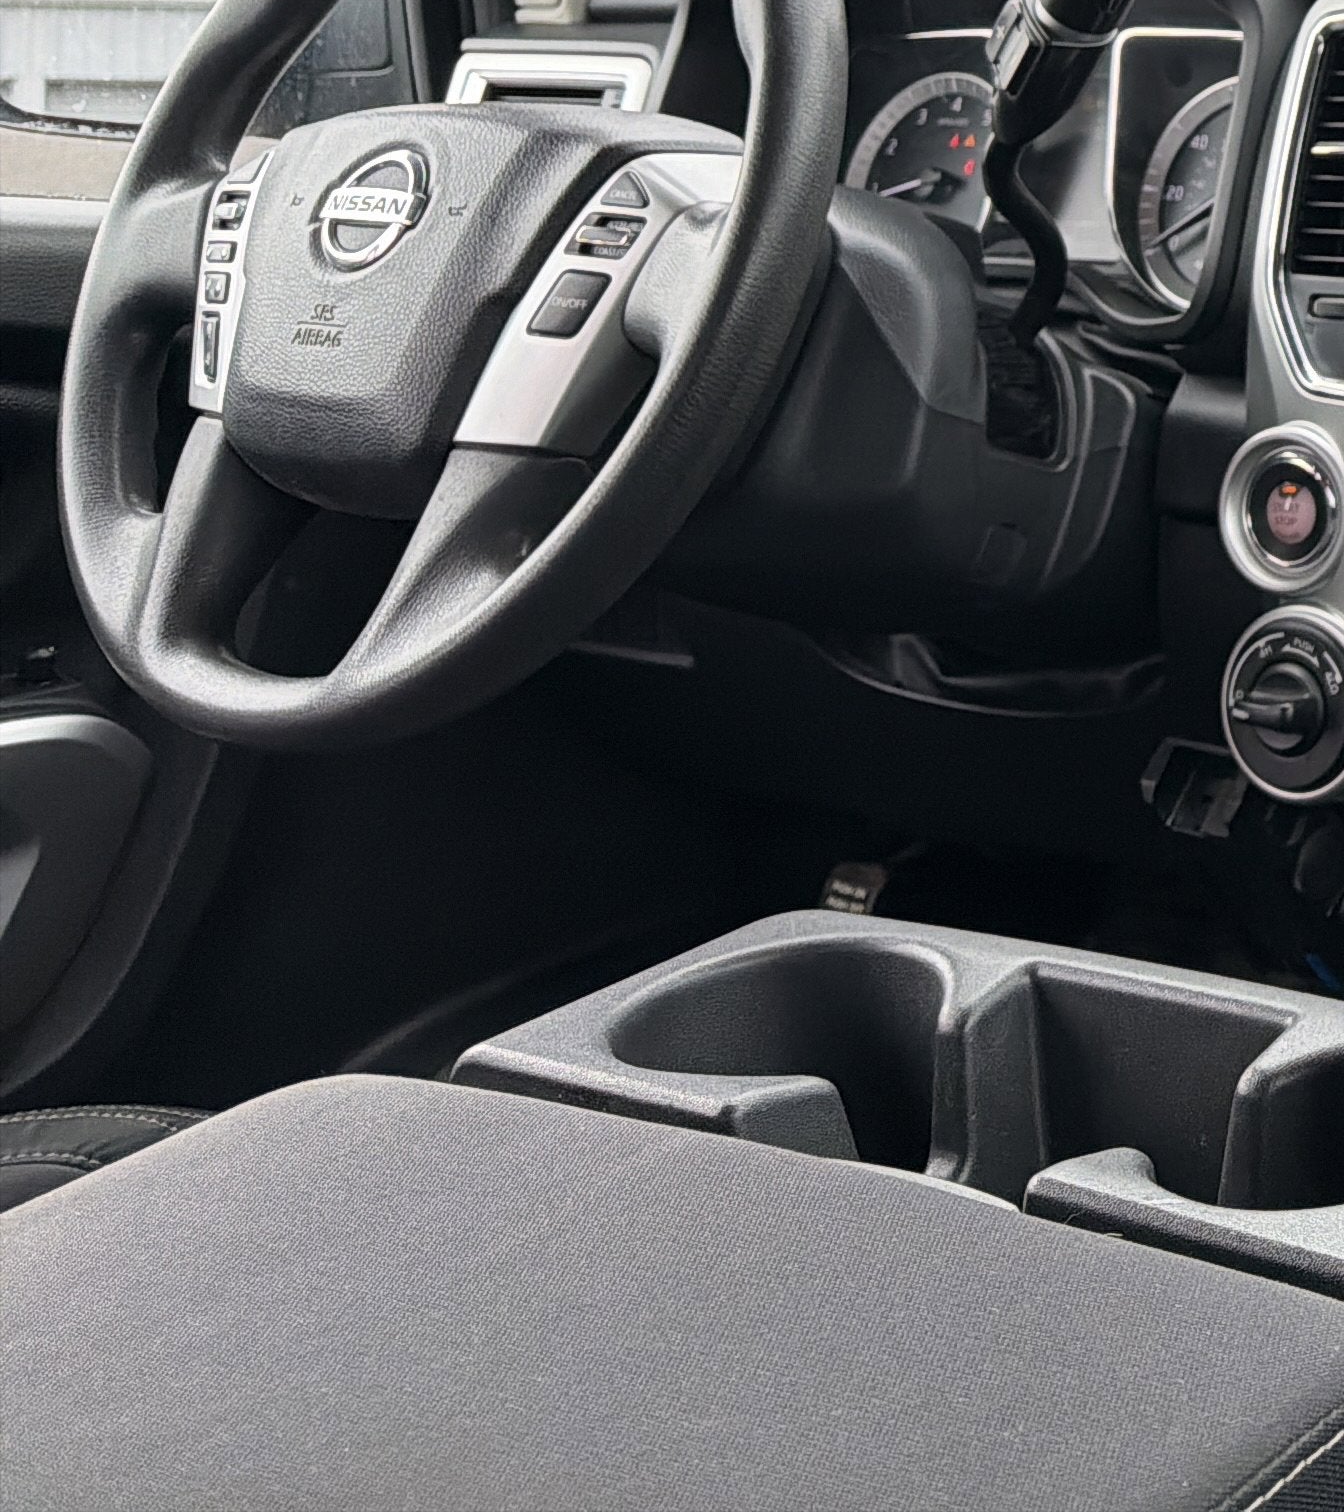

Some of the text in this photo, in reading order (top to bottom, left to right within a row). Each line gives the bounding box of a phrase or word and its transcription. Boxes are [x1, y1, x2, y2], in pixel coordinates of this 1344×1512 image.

[1191, 134, 1209, 149] 40
[1166, 185, 1184, 201] 20
[328, 195, 408, 216] NISSAN
[550, 297, 589, 310] ON/OFF
[291, 328, 344, 348] AIRBAG
